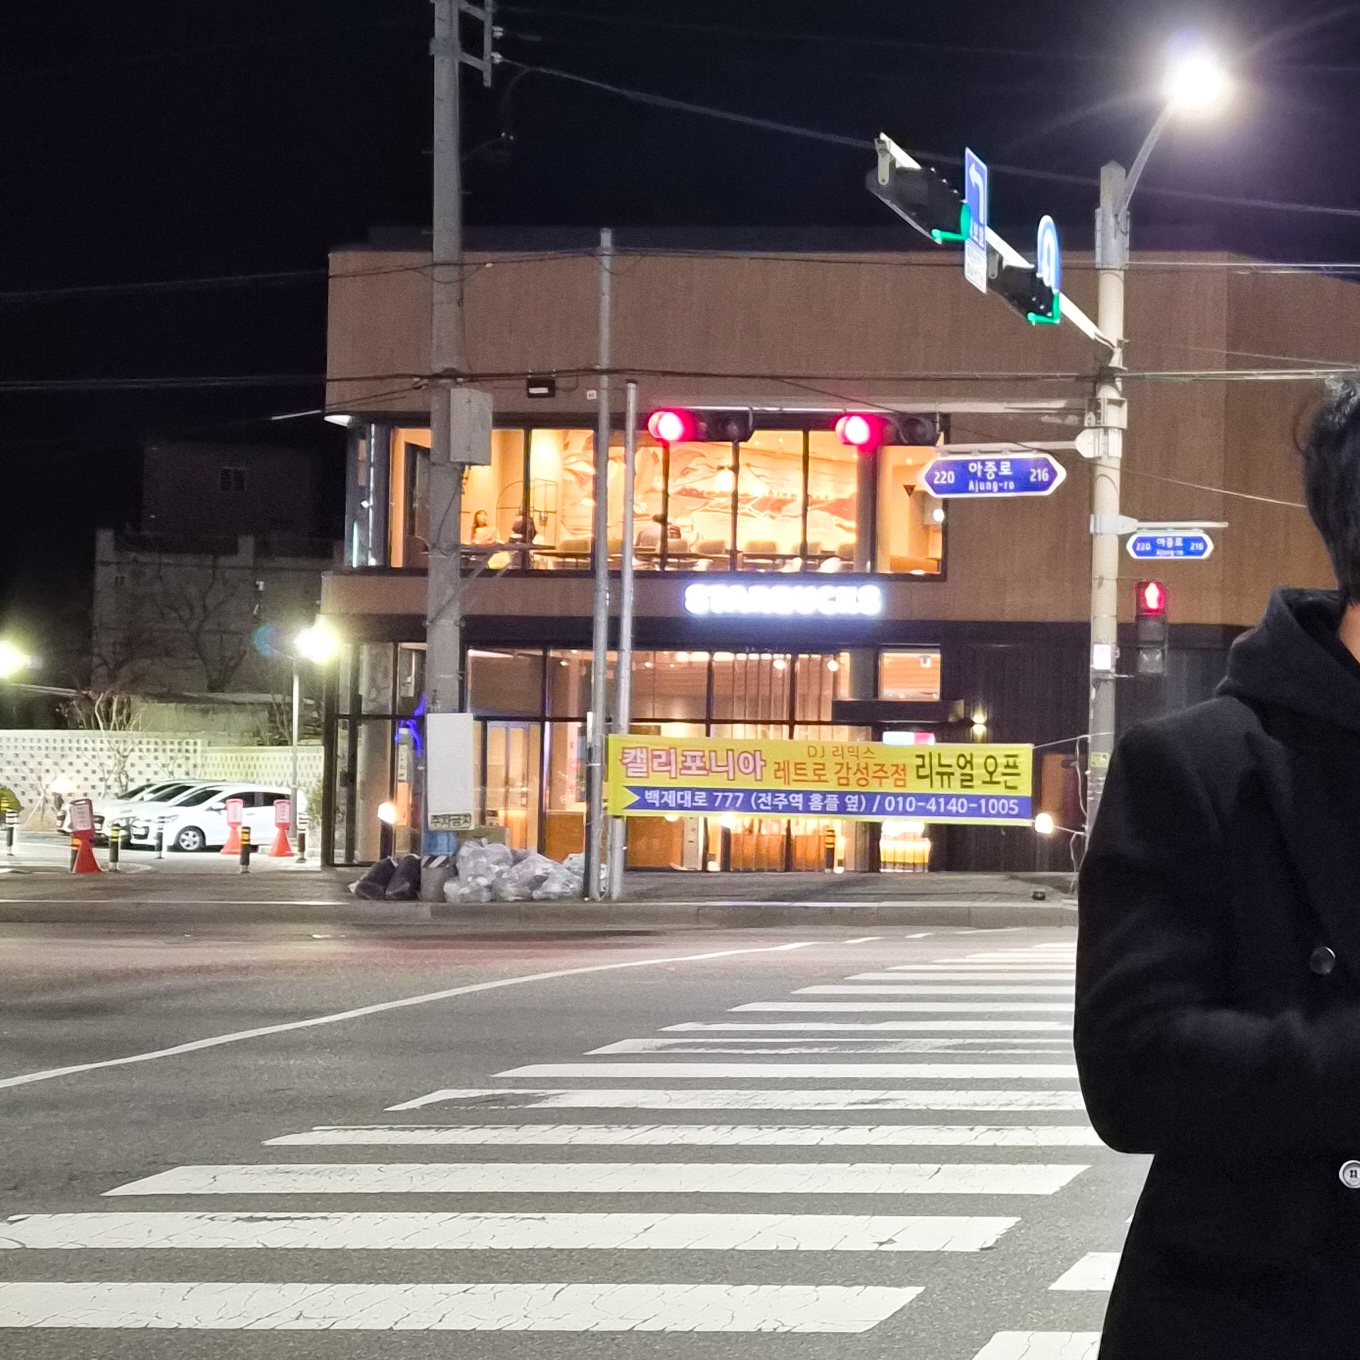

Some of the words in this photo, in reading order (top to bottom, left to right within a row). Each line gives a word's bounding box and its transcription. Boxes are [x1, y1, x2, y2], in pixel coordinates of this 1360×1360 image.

[933, 471, 955, 484] 220
[968, 461, 1013, 480] 아중로
[1029, 468, 1049, 482] 216
[968, 480, 1015, 492] Ajung-ro
[1156, 537, 1183, 549] 아중로
[807, 746, 825, 758] DJ
[831, 745, 875, 760] 리믹스
[621, 746, 766, 781] 캘리포니아
[774, 760, 829, 785] 레트로
[834, 762, 907, 788] 감성주점
[915, 752, 974, 789] 리뉴얼
[981, 754, 1021, 790] 오픈
[645, 790, 708, 808] 백제대로
[713, 792, 743, 808] 777
[751, 792, 803, 810] (전주역
[808, 794, 840, 812] 홈플
[844, 795, 866, 813] 옆)
[884, 796, 1019, 815] 010-4140-1005
